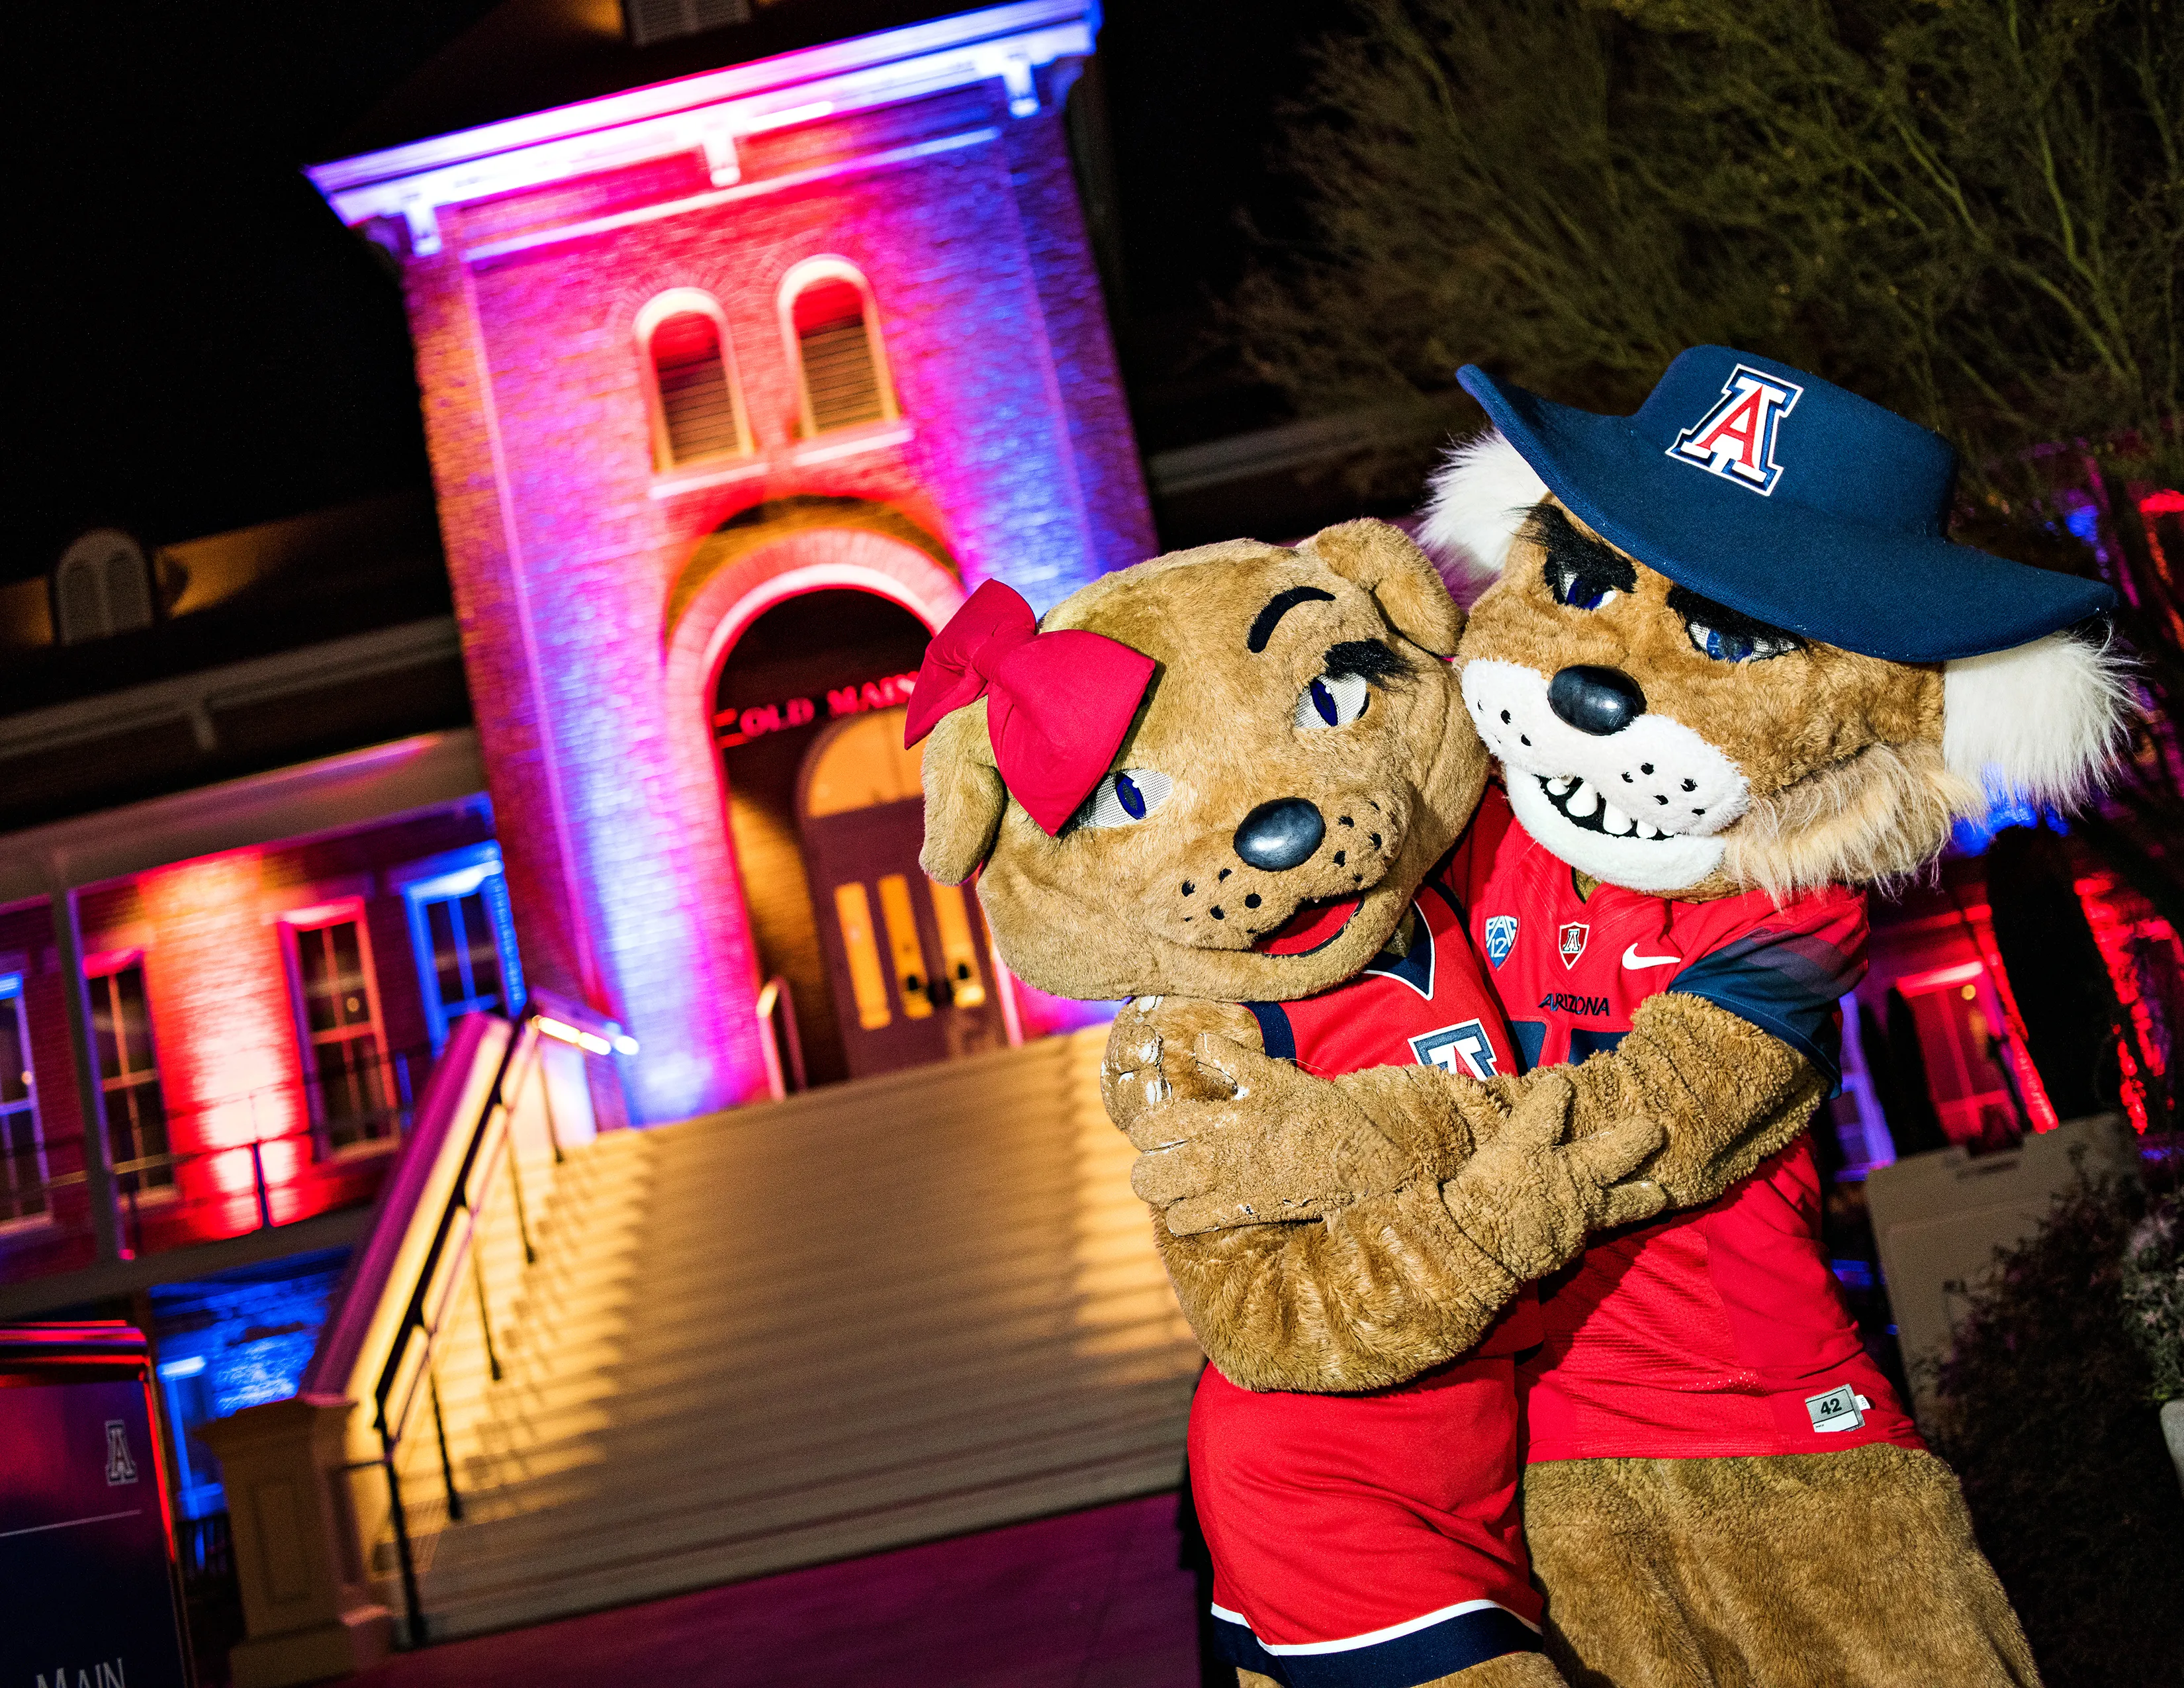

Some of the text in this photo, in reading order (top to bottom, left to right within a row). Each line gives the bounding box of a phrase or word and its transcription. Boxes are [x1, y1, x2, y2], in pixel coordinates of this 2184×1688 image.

[1665, 363, 1804, 496] A
[739, 697, 815, 737] OLD
[1485, 915, 1518, 948] PAC
[1562, 928, 1581, 954] A
[1490, 937, 1508, 958] 12
[1537, 992, 1610, 1017] ARIZONA
[1820, 1397, 1843, 1415] 42
[105, 1418, 139, 1487] A
